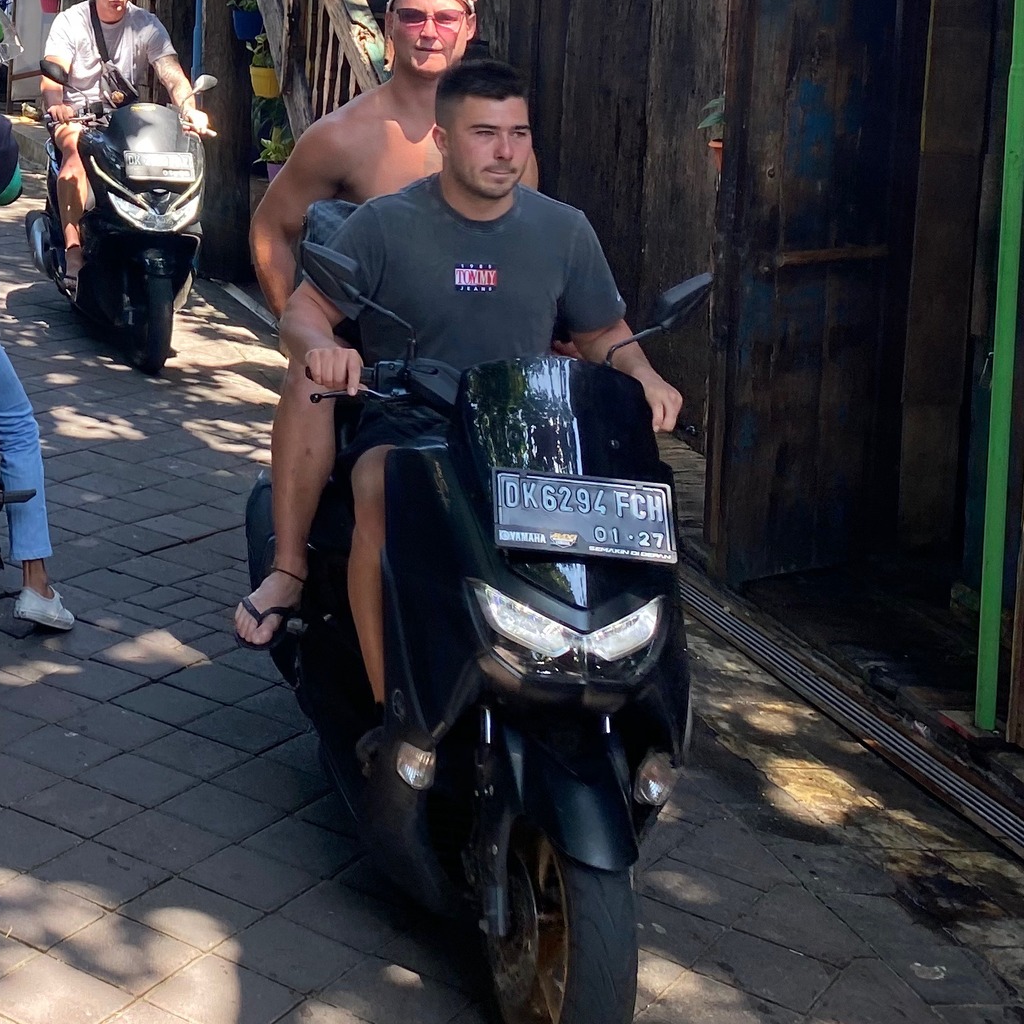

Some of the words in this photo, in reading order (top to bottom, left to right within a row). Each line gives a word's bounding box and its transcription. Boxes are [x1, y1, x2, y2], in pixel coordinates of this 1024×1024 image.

[456, 269, 496, 285] TOMMY
[613, 490, 664, 522] FCH
[509, 531, 547, 544] YAMAHA
[588, 546, 630, 555] SEMAKIN
